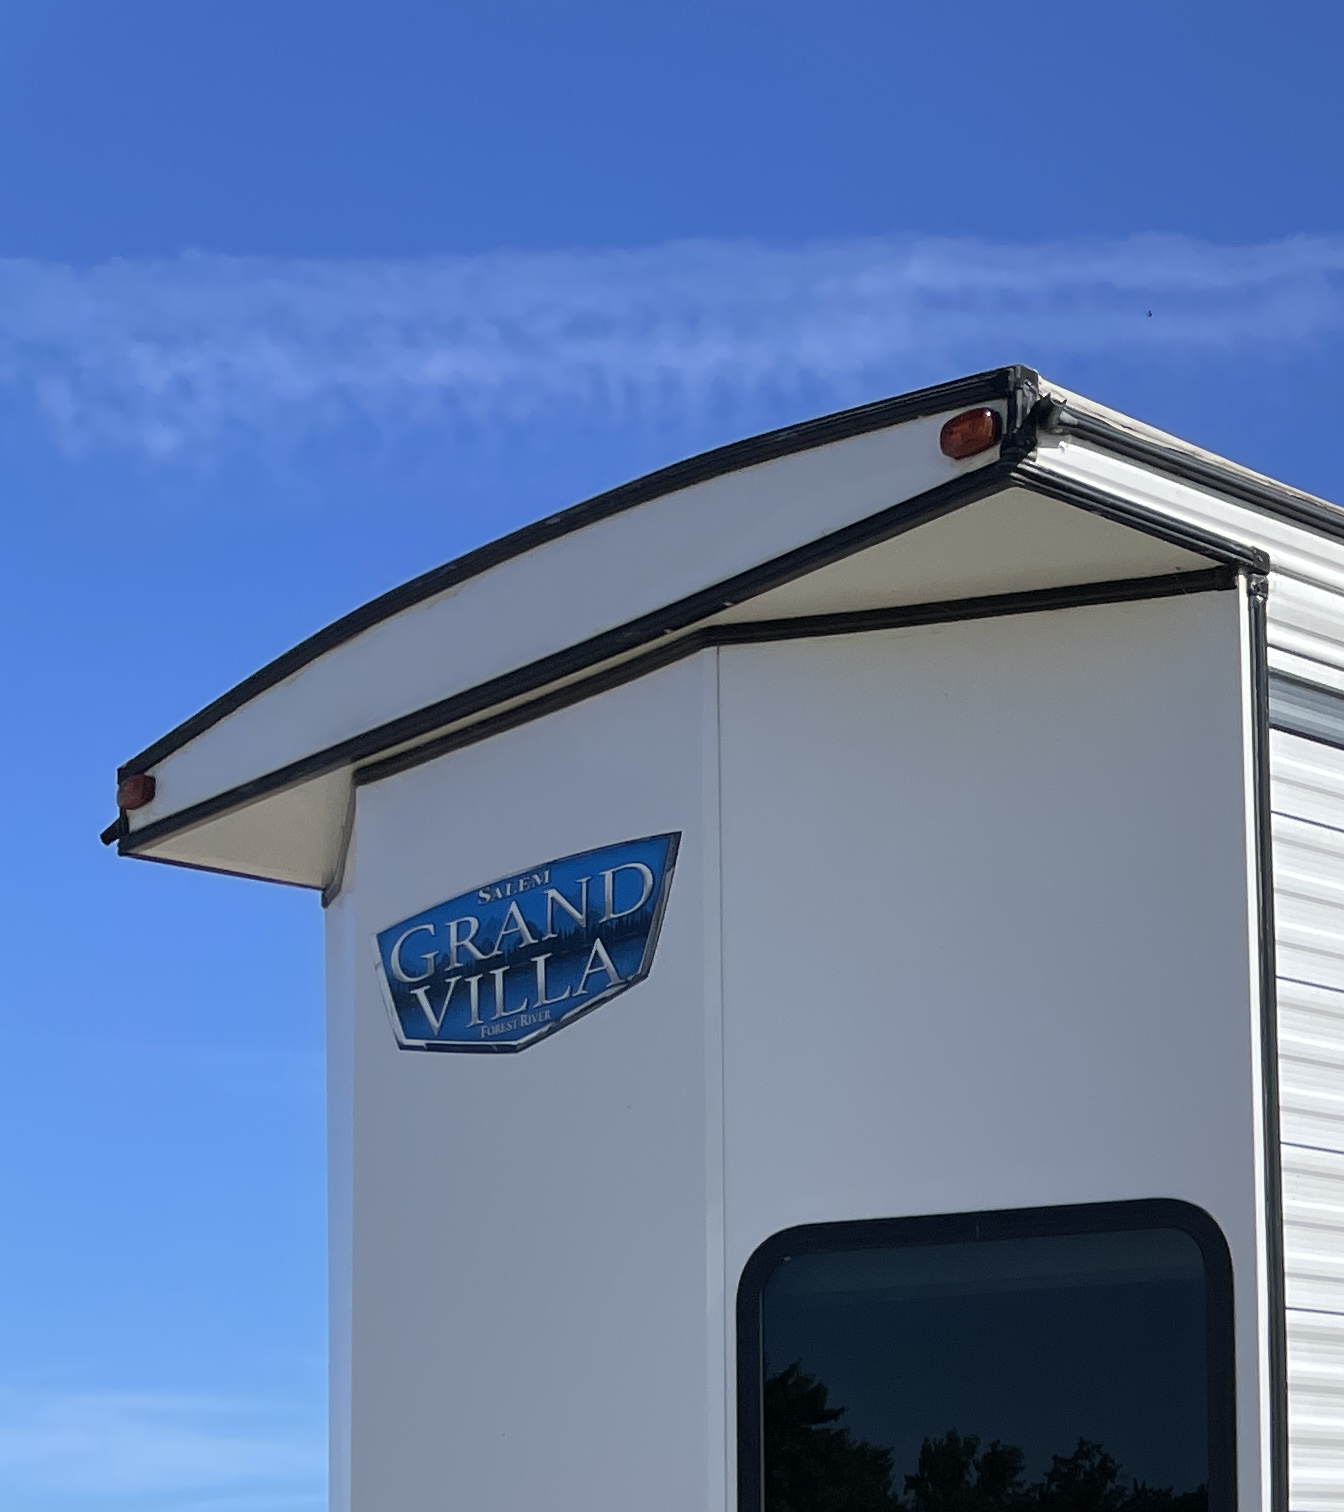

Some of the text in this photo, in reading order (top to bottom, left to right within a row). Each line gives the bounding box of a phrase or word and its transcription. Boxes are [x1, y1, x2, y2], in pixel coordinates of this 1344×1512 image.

[478, 869, 550, 905] SALEM
[390, 862, 654, 983] GRAND
[410, 937, 626, 1037] VILLA
[480, 1009, 551, 1039] FOREST RIVER
